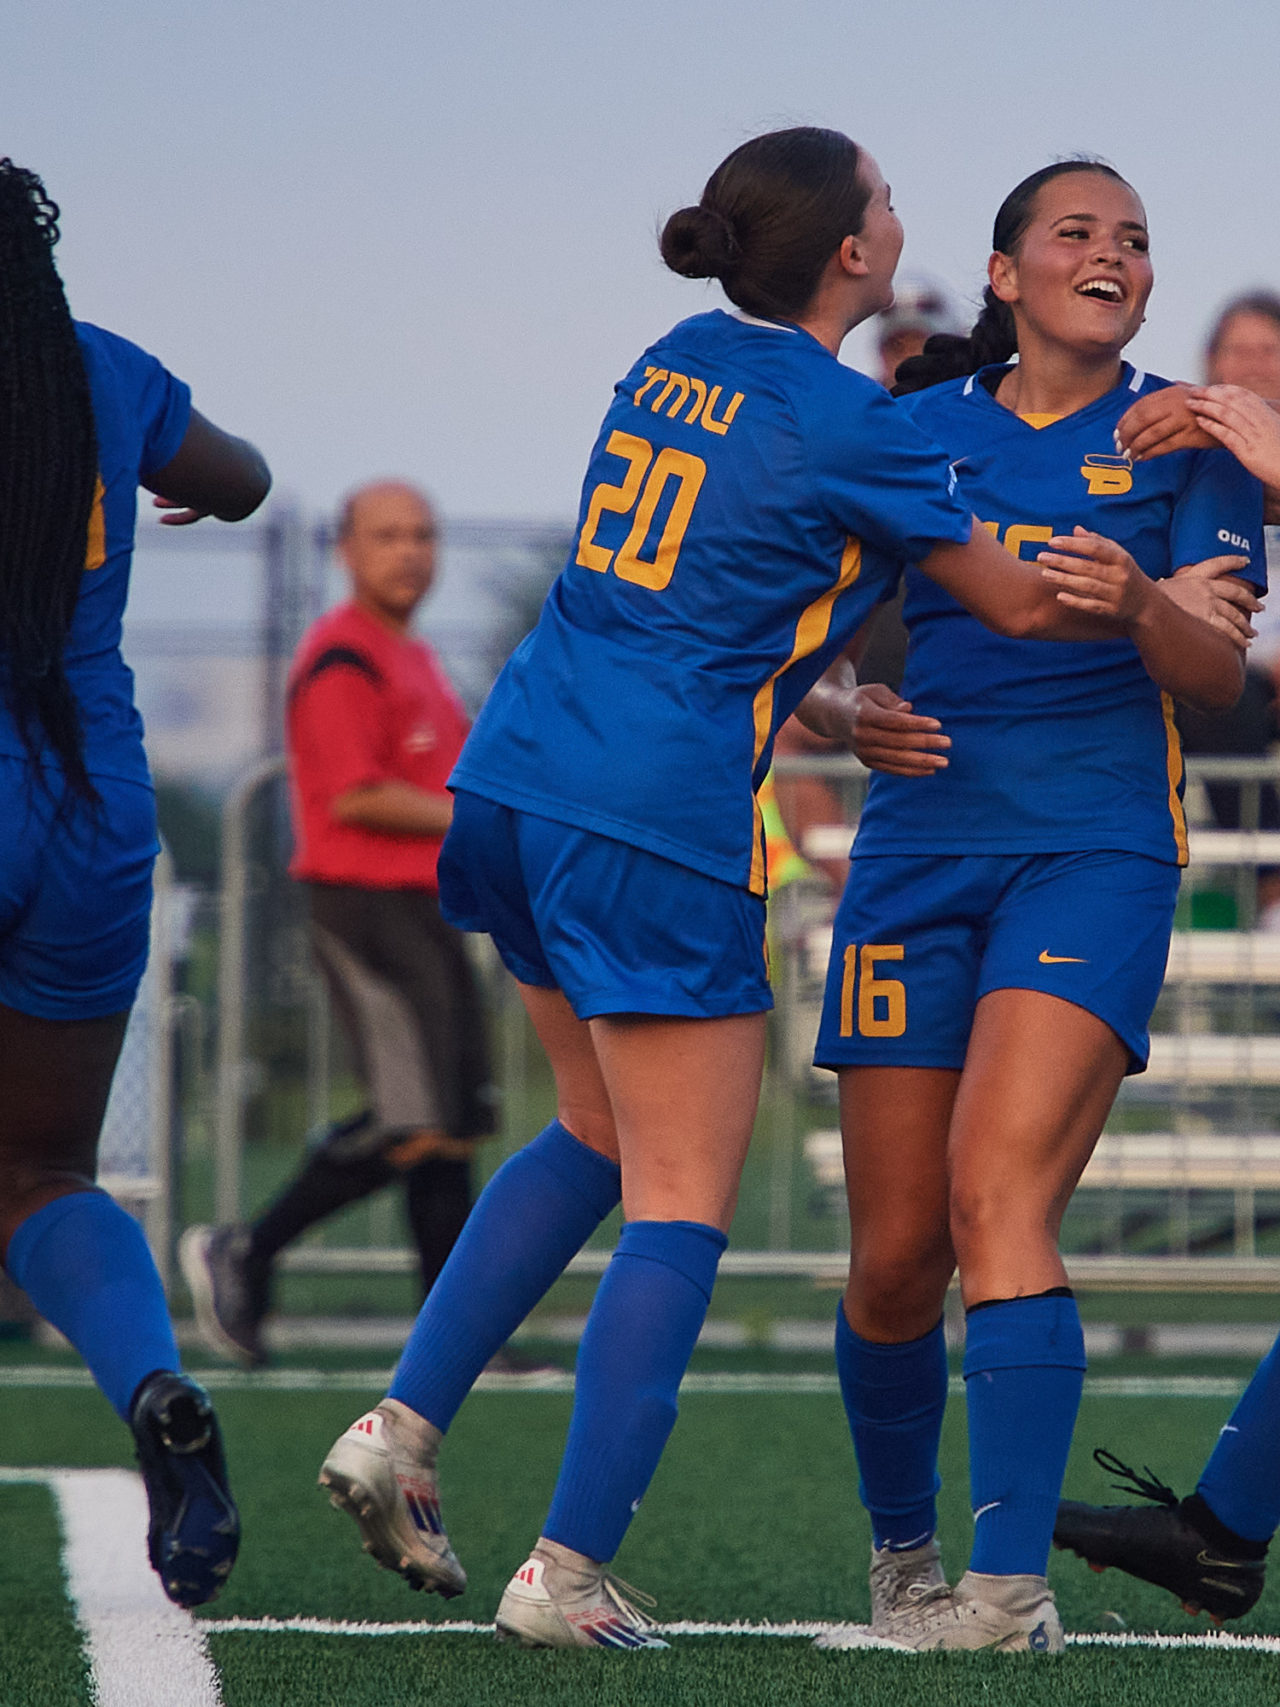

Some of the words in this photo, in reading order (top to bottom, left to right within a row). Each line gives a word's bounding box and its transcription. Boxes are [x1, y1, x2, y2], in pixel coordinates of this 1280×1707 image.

[633, 366, 745, 436] TMU
[575, 429, 707, 591] 20
[1217, 529, 1251, 552] OUA
[840, 944, 906, 1037] 16
